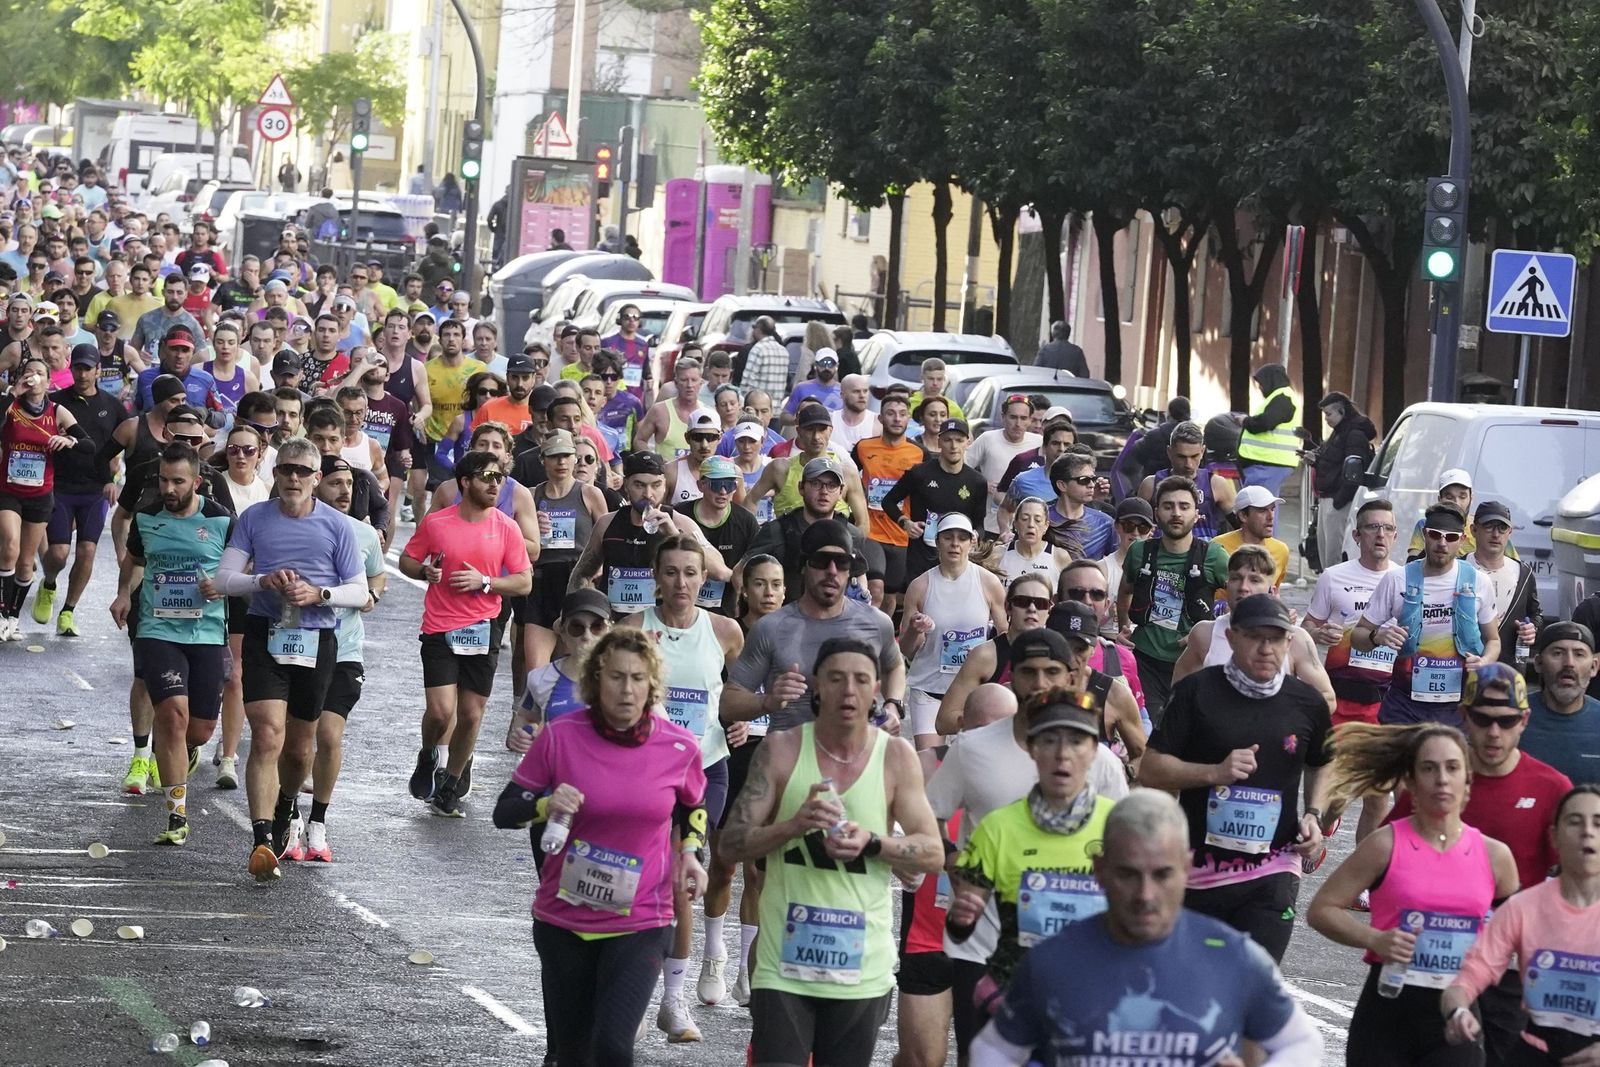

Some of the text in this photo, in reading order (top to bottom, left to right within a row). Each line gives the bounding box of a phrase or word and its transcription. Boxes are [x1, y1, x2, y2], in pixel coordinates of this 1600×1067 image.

[265, 118, 285, 131] 30
[16, 469, 37, 478] SOFIA
[552, 530, 568, 539] ECA
[168, 575, 197, 583] ZURICH
[623, 570, 651, 578] ZURICH
[620, 592, 643, 602] LIAM
[701, 590, 715, 599] DIE
[161, 597, 193, 608] GARRO
[1151, 604, 1174, 619] RLOS
[1423, 607, 1454, 619] RATHO
[451, 635, 483, 645] MICHEL
[282, 643, 305, 653] RICO
[1355, 648, 1395, 662] LAURENT
[1430, 659, 1457, 667] ZURICH
[1428, 682, 1446, 692] ELS
[666, 690, 702, 701] ZURICH
[1234, 790, 1274, 803] ZURICH
[1234, 809, 1255, 820] 9513
[1219, 821, 1266, 838] JAVITO
[576, 879, 614, 901] RUTH
[1050, 878, 1100, 892] ZURICH
[812, 911, 858, 925] ZURICH
[1428, 916, 1472, 929] ZURICH
[812, 934, 836, 946] 7789
[1428, 938, 1453, 950] 7144
[795, 946, 849, 967] XAVITO
[1543, 992, 1597, 1017] MIREN
[1093, 1030, 1199, 1056] MEDIA
